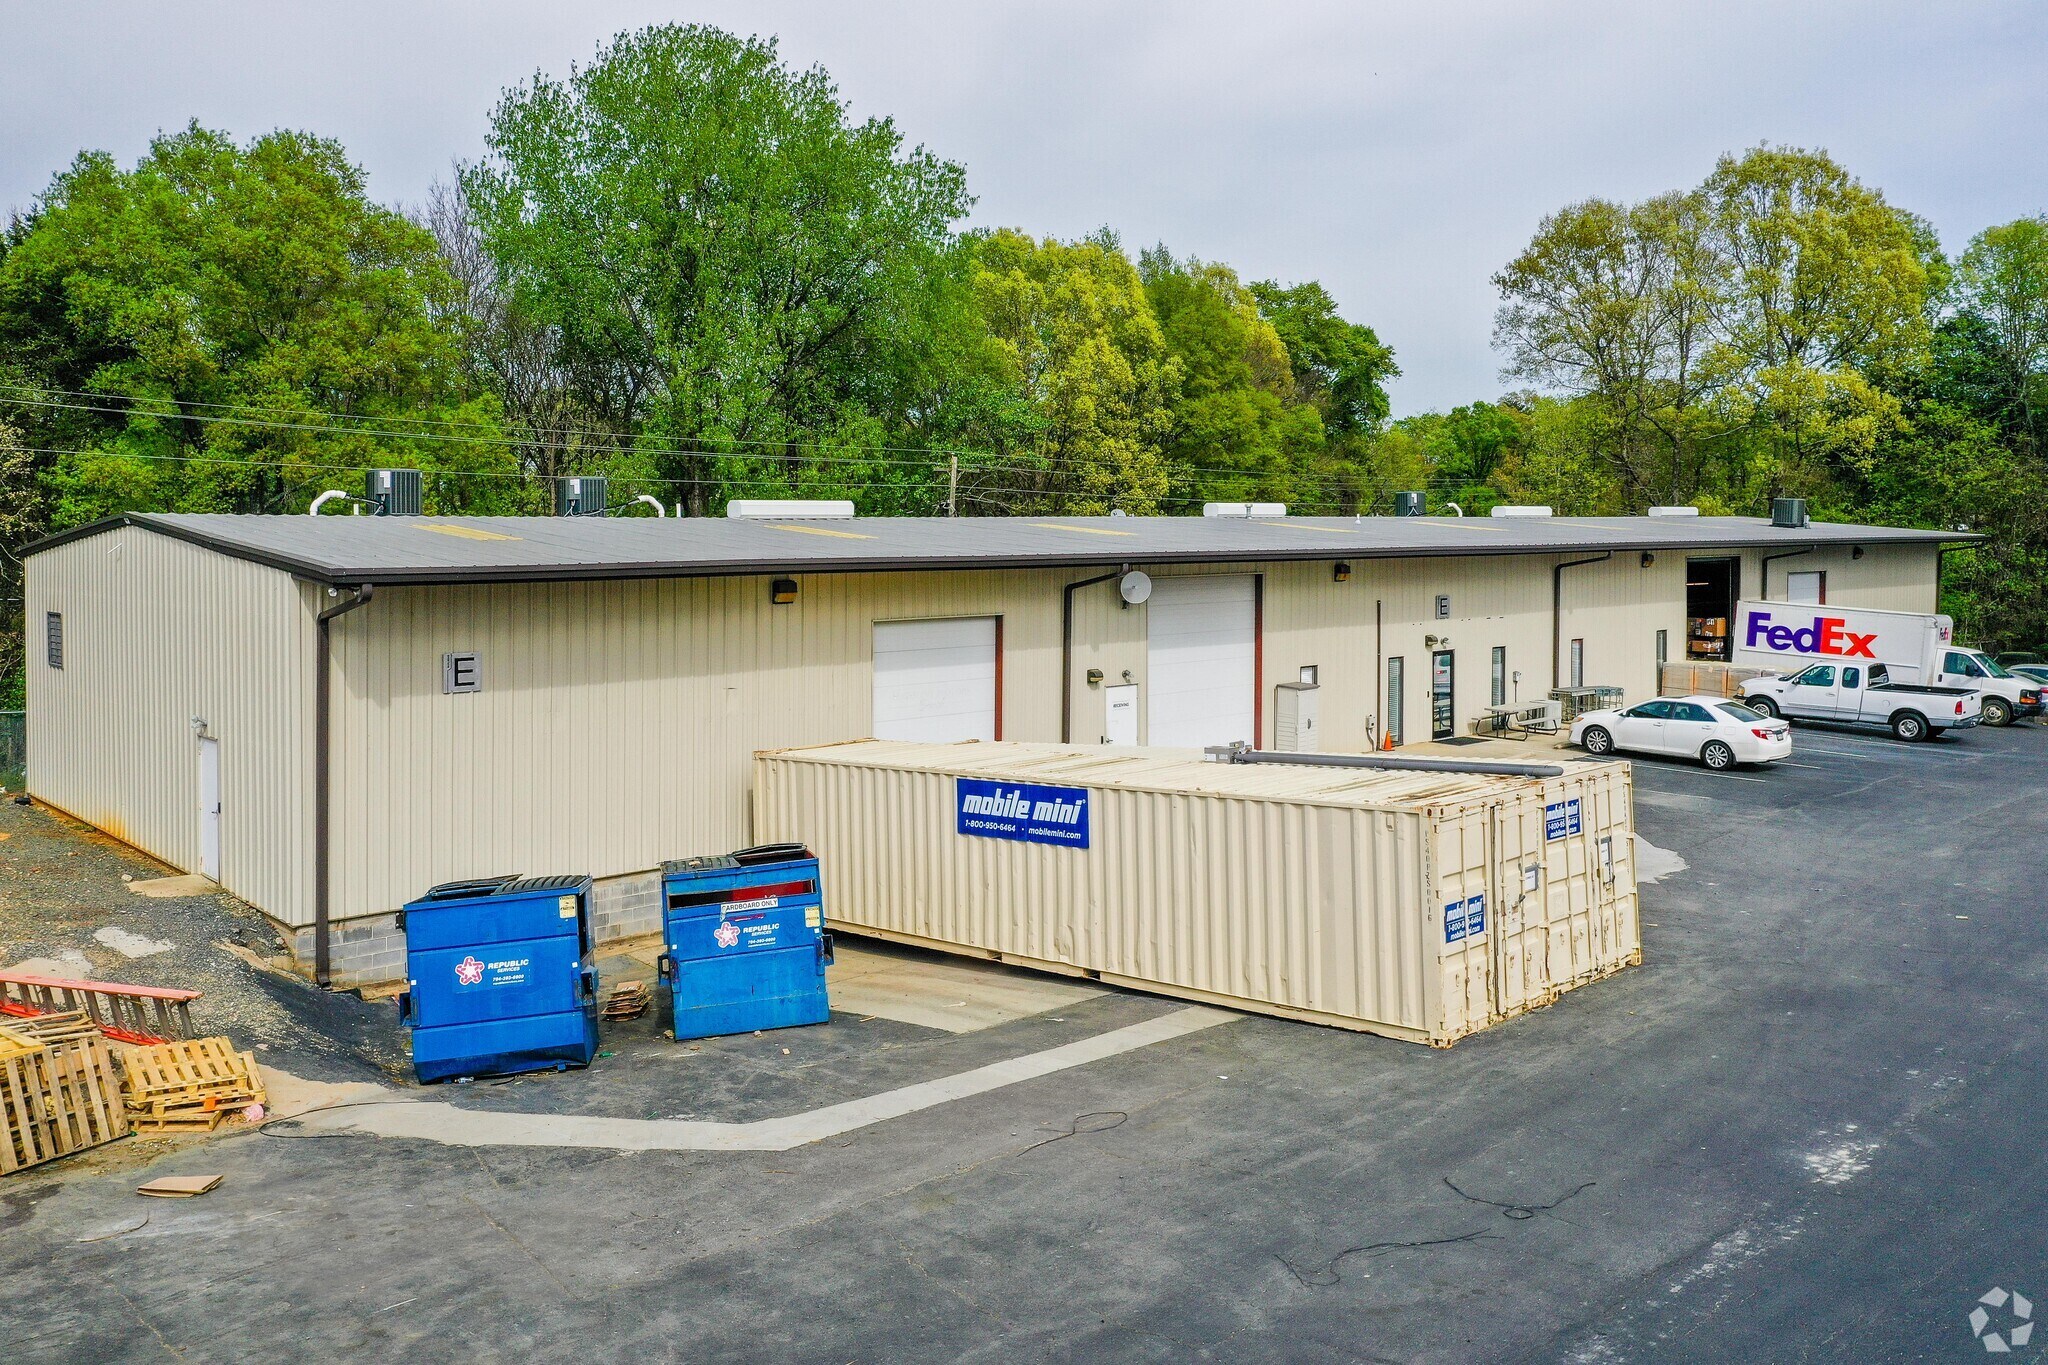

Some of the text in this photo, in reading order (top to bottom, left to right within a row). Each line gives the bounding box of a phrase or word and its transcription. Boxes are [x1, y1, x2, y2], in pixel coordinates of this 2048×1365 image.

[1440, 598, 1448, 615] E
[1746, 611, 1878, 659] FedEx
[454, 656, 475, 687] E
[962, 788, 1031, 820] mobile
[965, 819, 1082, 840] 1-800-950-6464 mobilemini.com
[742, 923, 780, 934] REPUBLIC
[487, 959, 529, 970] REPUBLIC
